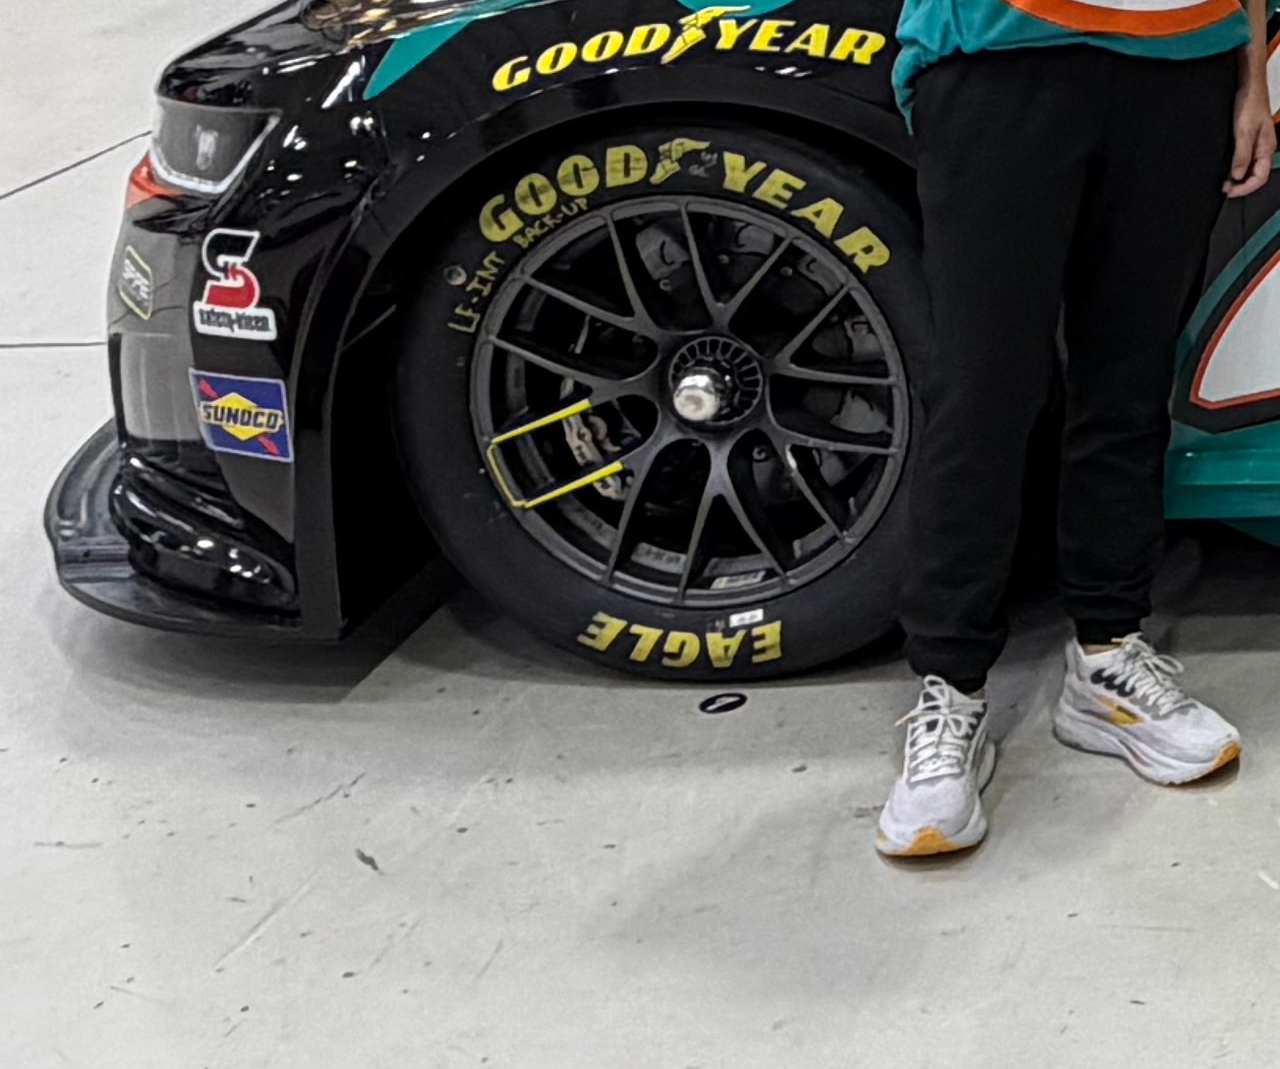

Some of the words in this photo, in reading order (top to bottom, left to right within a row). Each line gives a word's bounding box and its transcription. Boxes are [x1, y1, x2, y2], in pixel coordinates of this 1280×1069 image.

[512, 198, 591, 249] BACK-UP
[203, 404, 280, 431] SUNOCO
[577, 611, 783, 669] EAGLE
